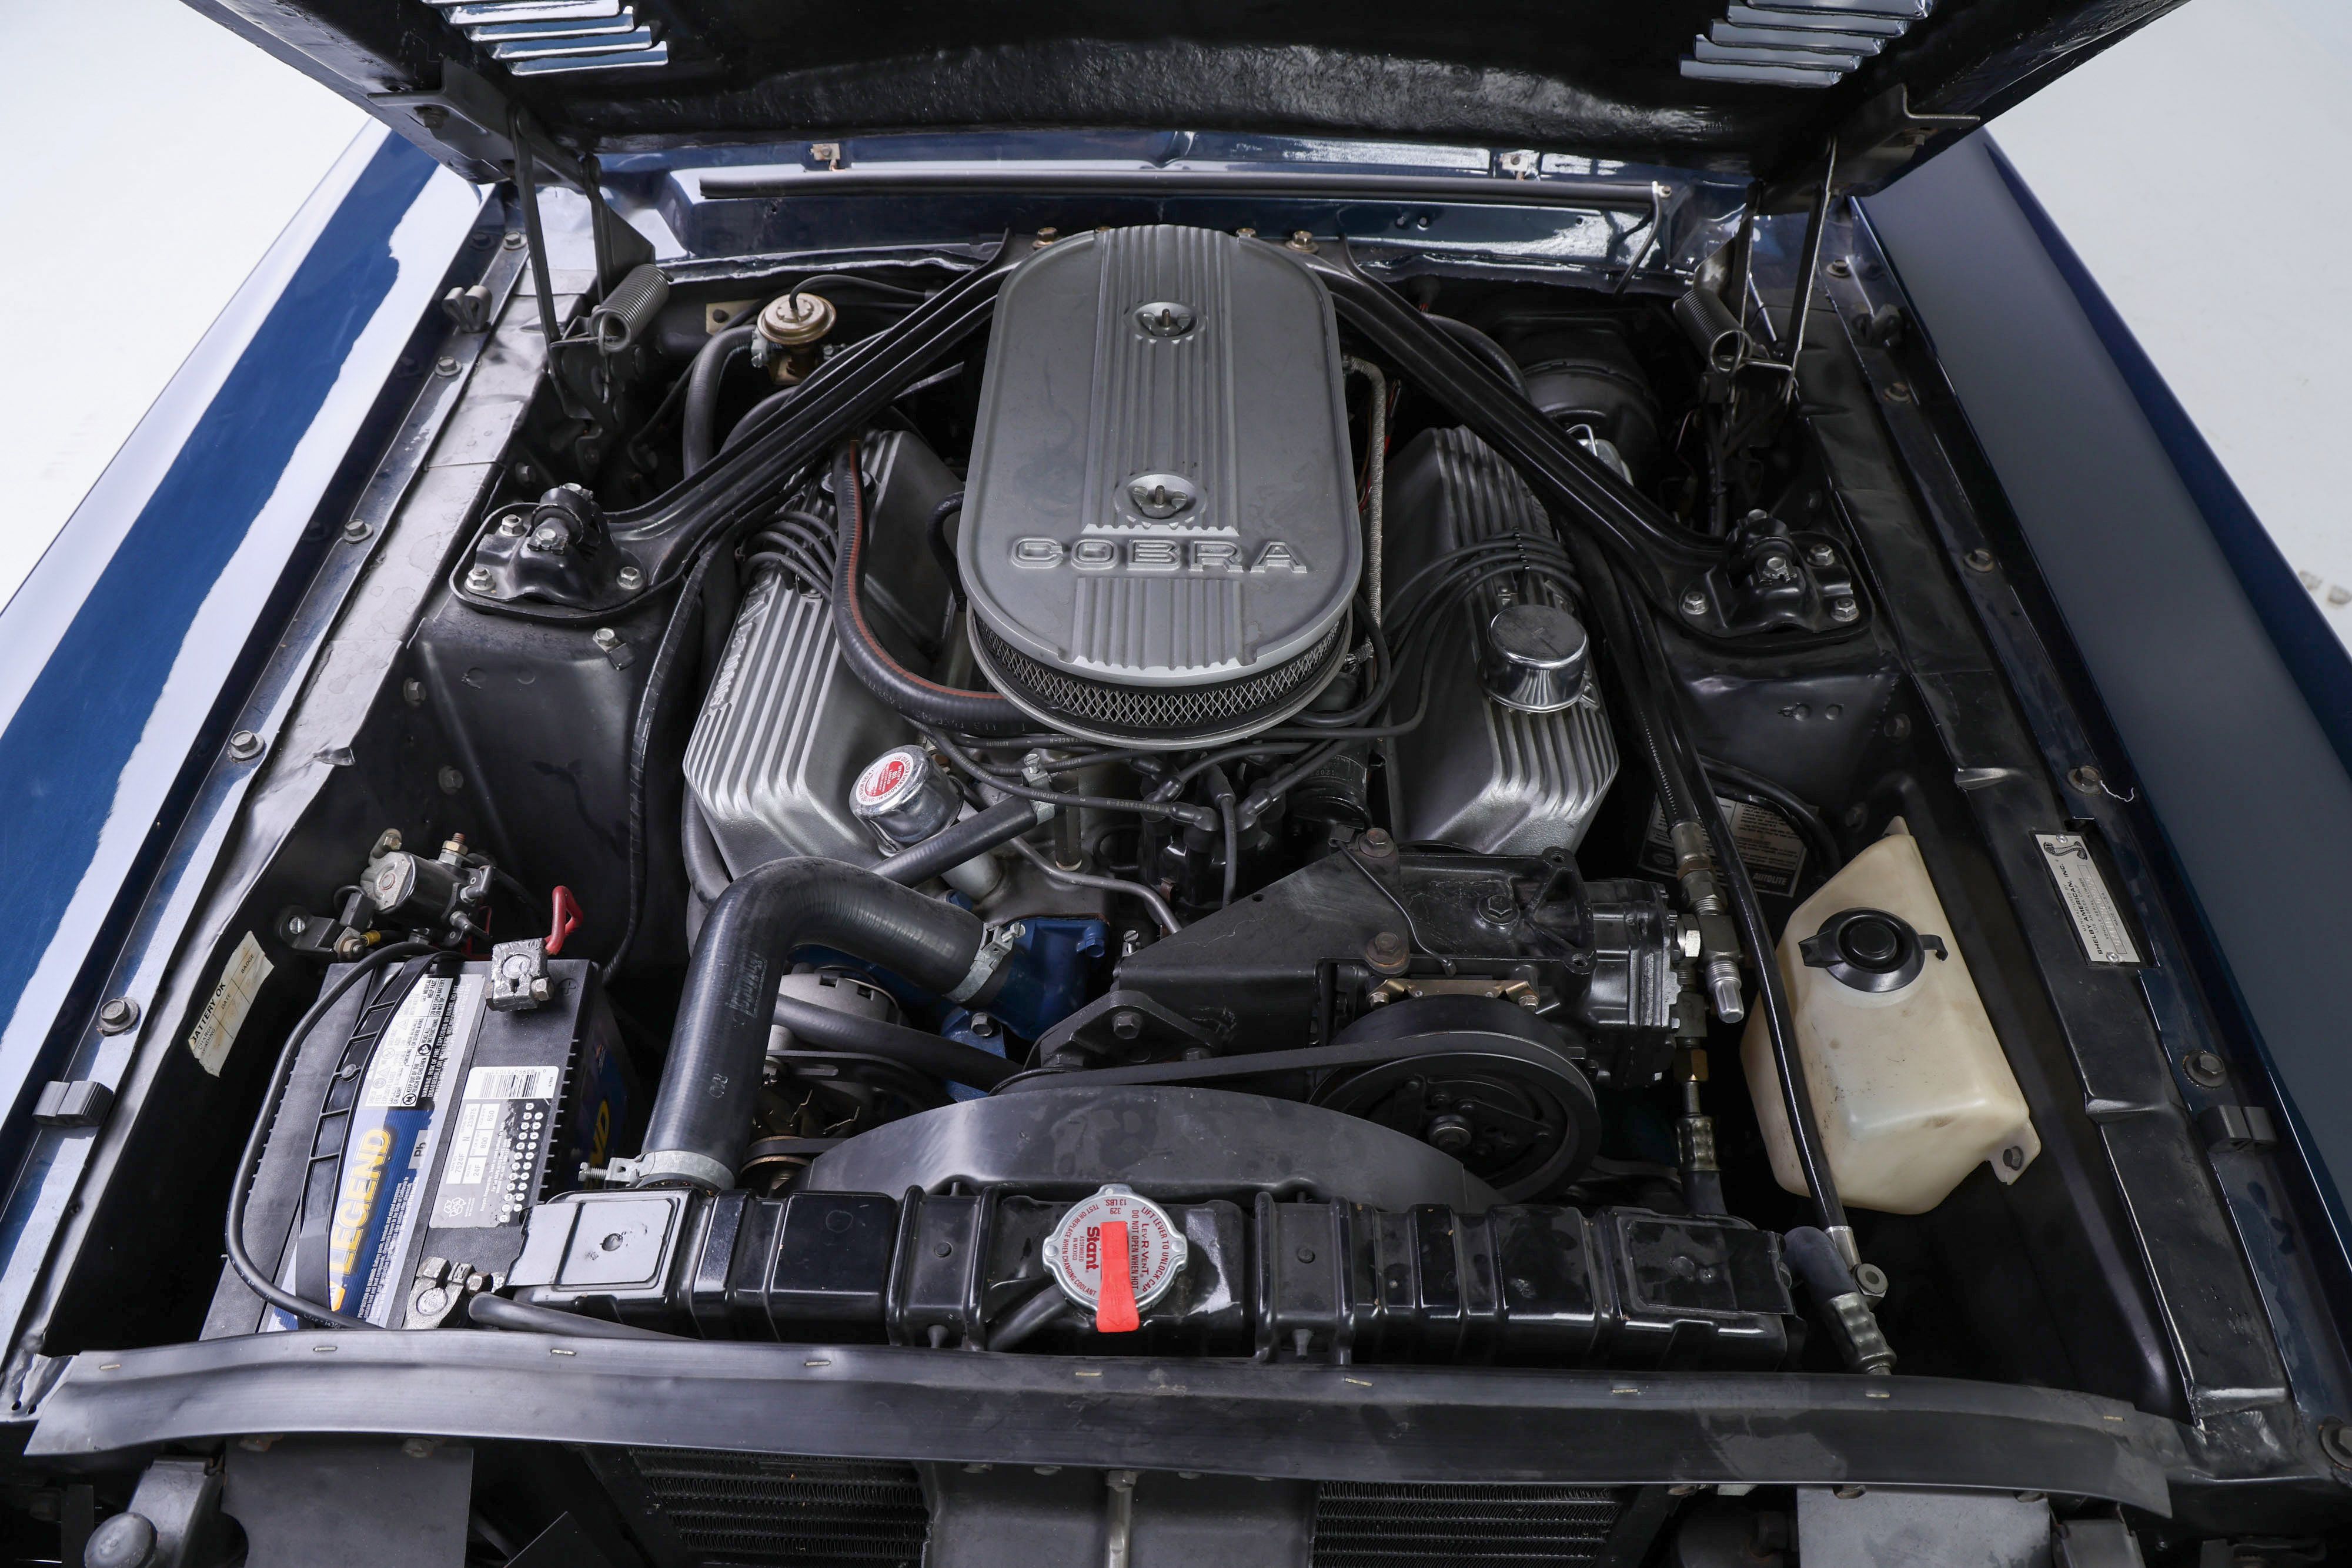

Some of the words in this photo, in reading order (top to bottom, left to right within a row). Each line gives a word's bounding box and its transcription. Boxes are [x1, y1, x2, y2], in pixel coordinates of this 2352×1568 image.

[1010, 537, 1308, 574] COBRA
[1030, 790, 1058, 799] AUTOLITE
[1752, 872, 1788, 885] AUTOLITE
[2058, 863, 2069, 877] INC.
[2078, 877, 2091, 898] NUMBER
[2066, 892, 2087, 931] MANUFACTURED
[2088, 900, 2100, 917] SERIAL
[2109, 912, 2119, 925] MADE
[2097, 919, 2110, 939] VEHICLE
[2085, 924, 2103, 954] SHELBY
[240, 953, 255, 974] BADGE
[215, 981, 226, 998] OK
[422, 979, 432, 994] MEDICAL
[436, 978, 446, 993] BATTERY.
[220, 992, 232, 1010] DATE
[426, 1018, 439, 1043] INSTRUCTIONS.
[420, 1075, 432, 1097] WARNING:
[427, 1065, 436, 1075] RISK
[436, 1024, 448, 1045] EXPLOSION
[427, 1068, 441, 1096] DISASSEMBLE
[486, 1110, 495, 1121] 650
[413, 1142, 427, 1156] Pb
[480, 1137, 488, 1148] 800
[454, 1153, 465, 1172] 7524F
[472, 1165, 482, 1176] 24F
[330, 1128, 391, 1275] LEGEND
[1086, 1203, 1098, 1213] TEST
[1131, 1210, 1138, 1218] DO
[1141, 1206, 1154, 1219] LIFT
[1064, 1216, 1081, 1238] REPLACE
[1152, 1219, 1167, 1238] LEVER
[1085, 1226, 1100, 1270] Stant
[1162, 1240, 1168, 1249] TO
[357, 1292, 369, 1318] PROPOSITION
[366, 1267, 377, 1286] WARNING:
[372, 1253, 382, 1266] Battery
[380, 1224, 390, 1241] terminals
[387, 1203, 396, 1216] related
[1061, 1255, 1077, 1280] CHANGING
[1152, 1252, 1168, 1279] UNLOCK
[1074, 1279, 1096, 1296] COOLANT
[1141, 1279, 1155, 1293] CAP
[362, 1303, 372, 1318] contain
